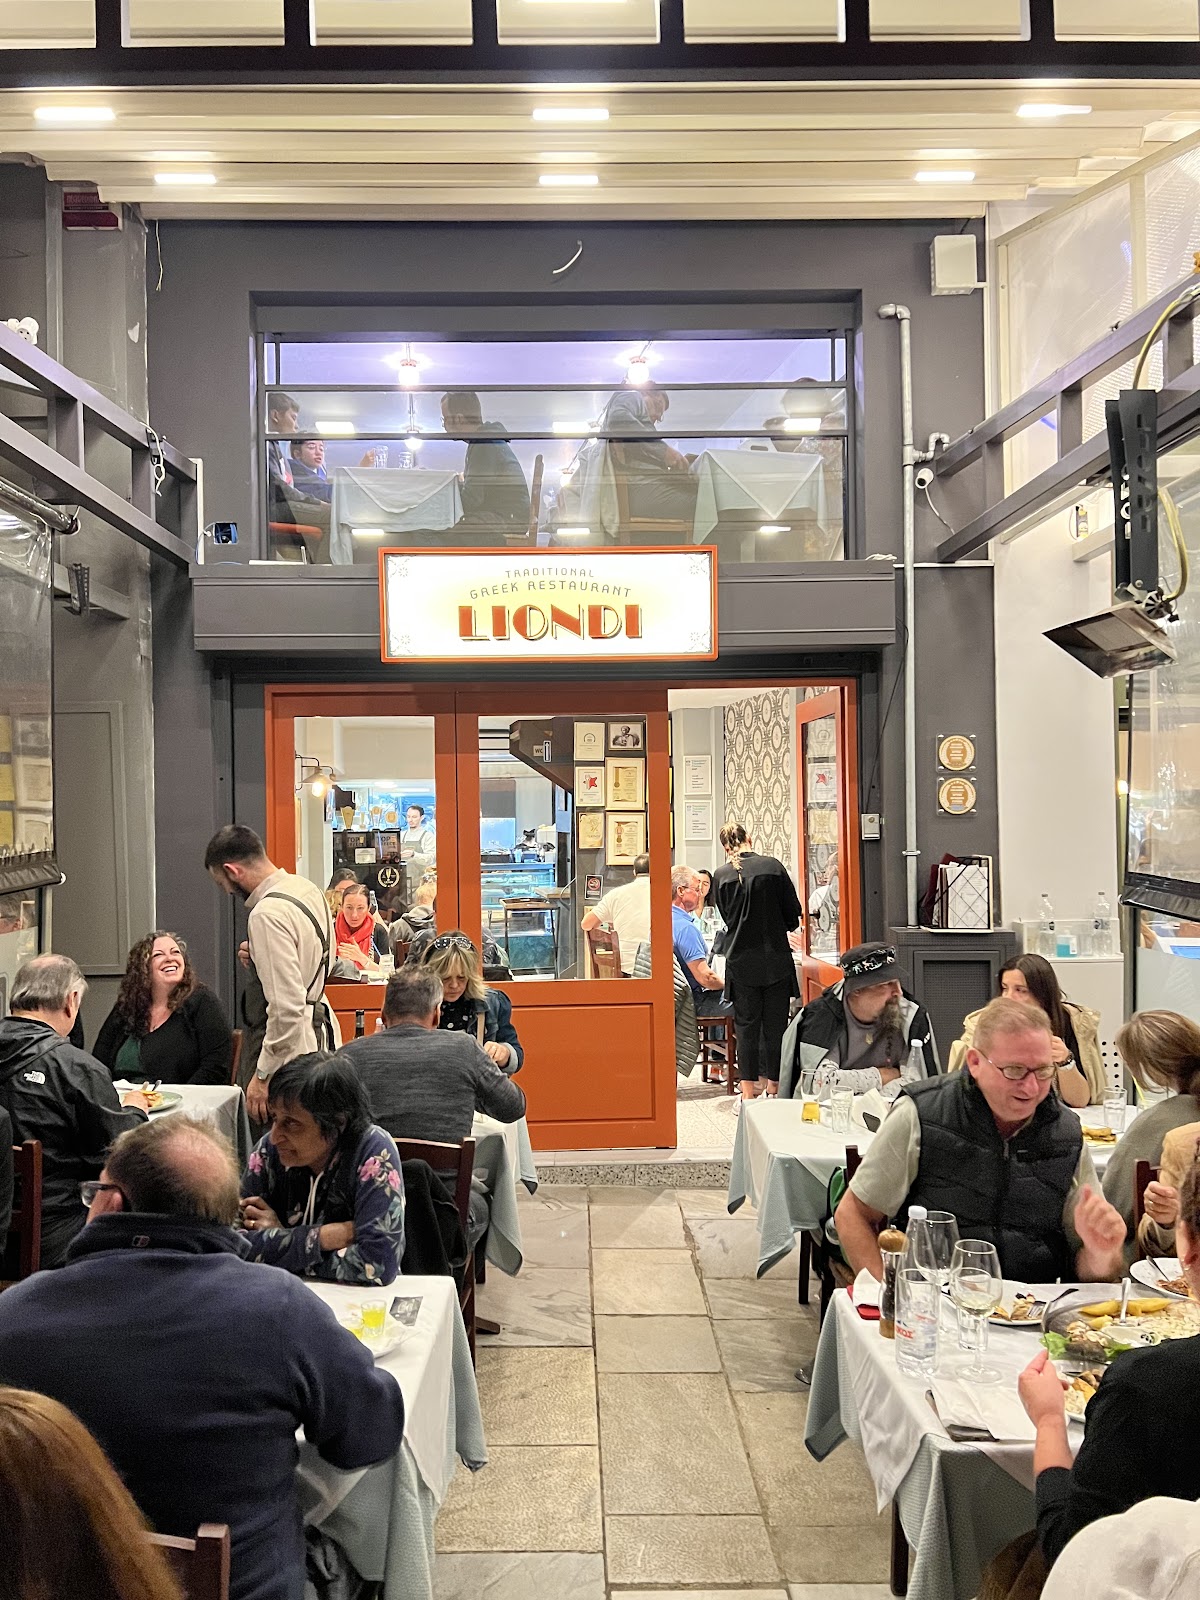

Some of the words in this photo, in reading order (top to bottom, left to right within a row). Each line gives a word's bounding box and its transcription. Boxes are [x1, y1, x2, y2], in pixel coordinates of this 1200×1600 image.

[505, 567, 594, 579] TRADITIONAL
[469, 581, 519, 600] GREEK
[528, 580, 631, 598] RESTAURANT
[458, 603, 642, 641] LIONDI
